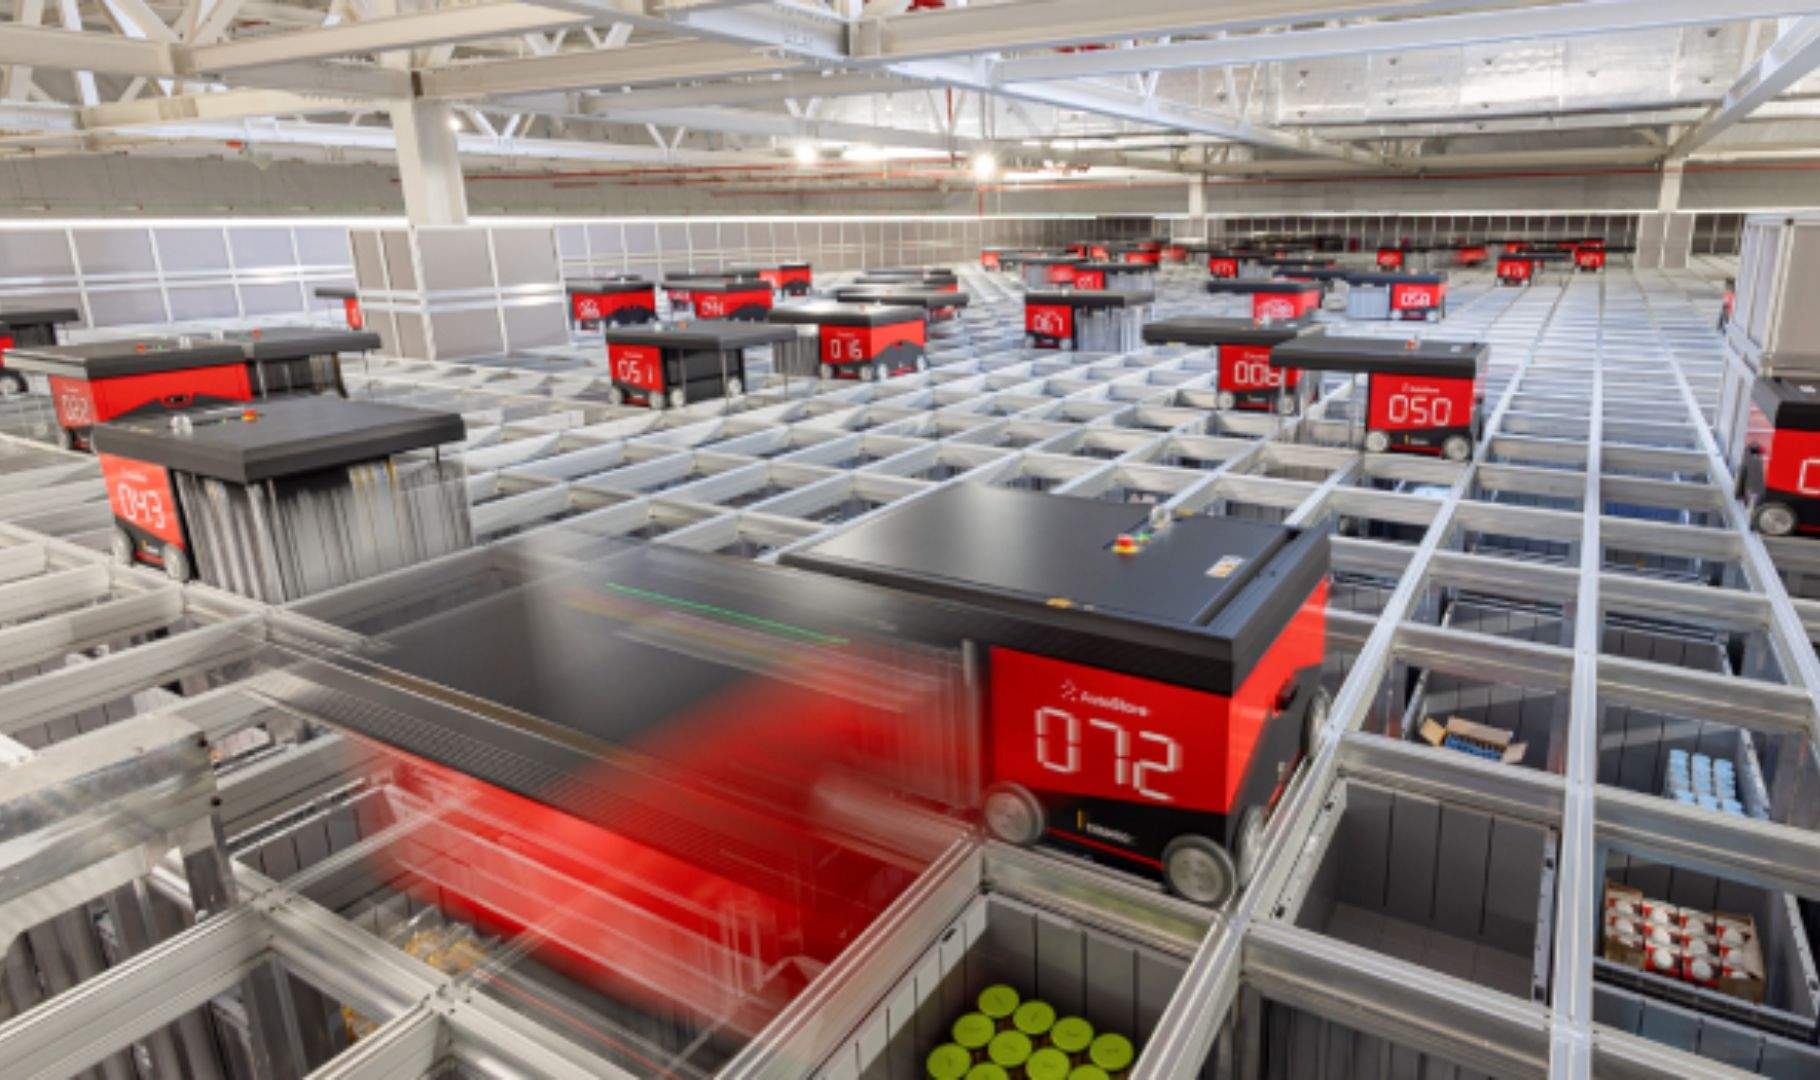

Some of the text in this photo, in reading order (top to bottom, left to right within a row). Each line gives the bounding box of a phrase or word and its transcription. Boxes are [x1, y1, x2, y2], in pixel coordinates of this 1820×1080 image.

[1388, 394, 1452, 426] 050
[117, 482, 166, 529] 043
[1034, 706, 1181, 801] 072
